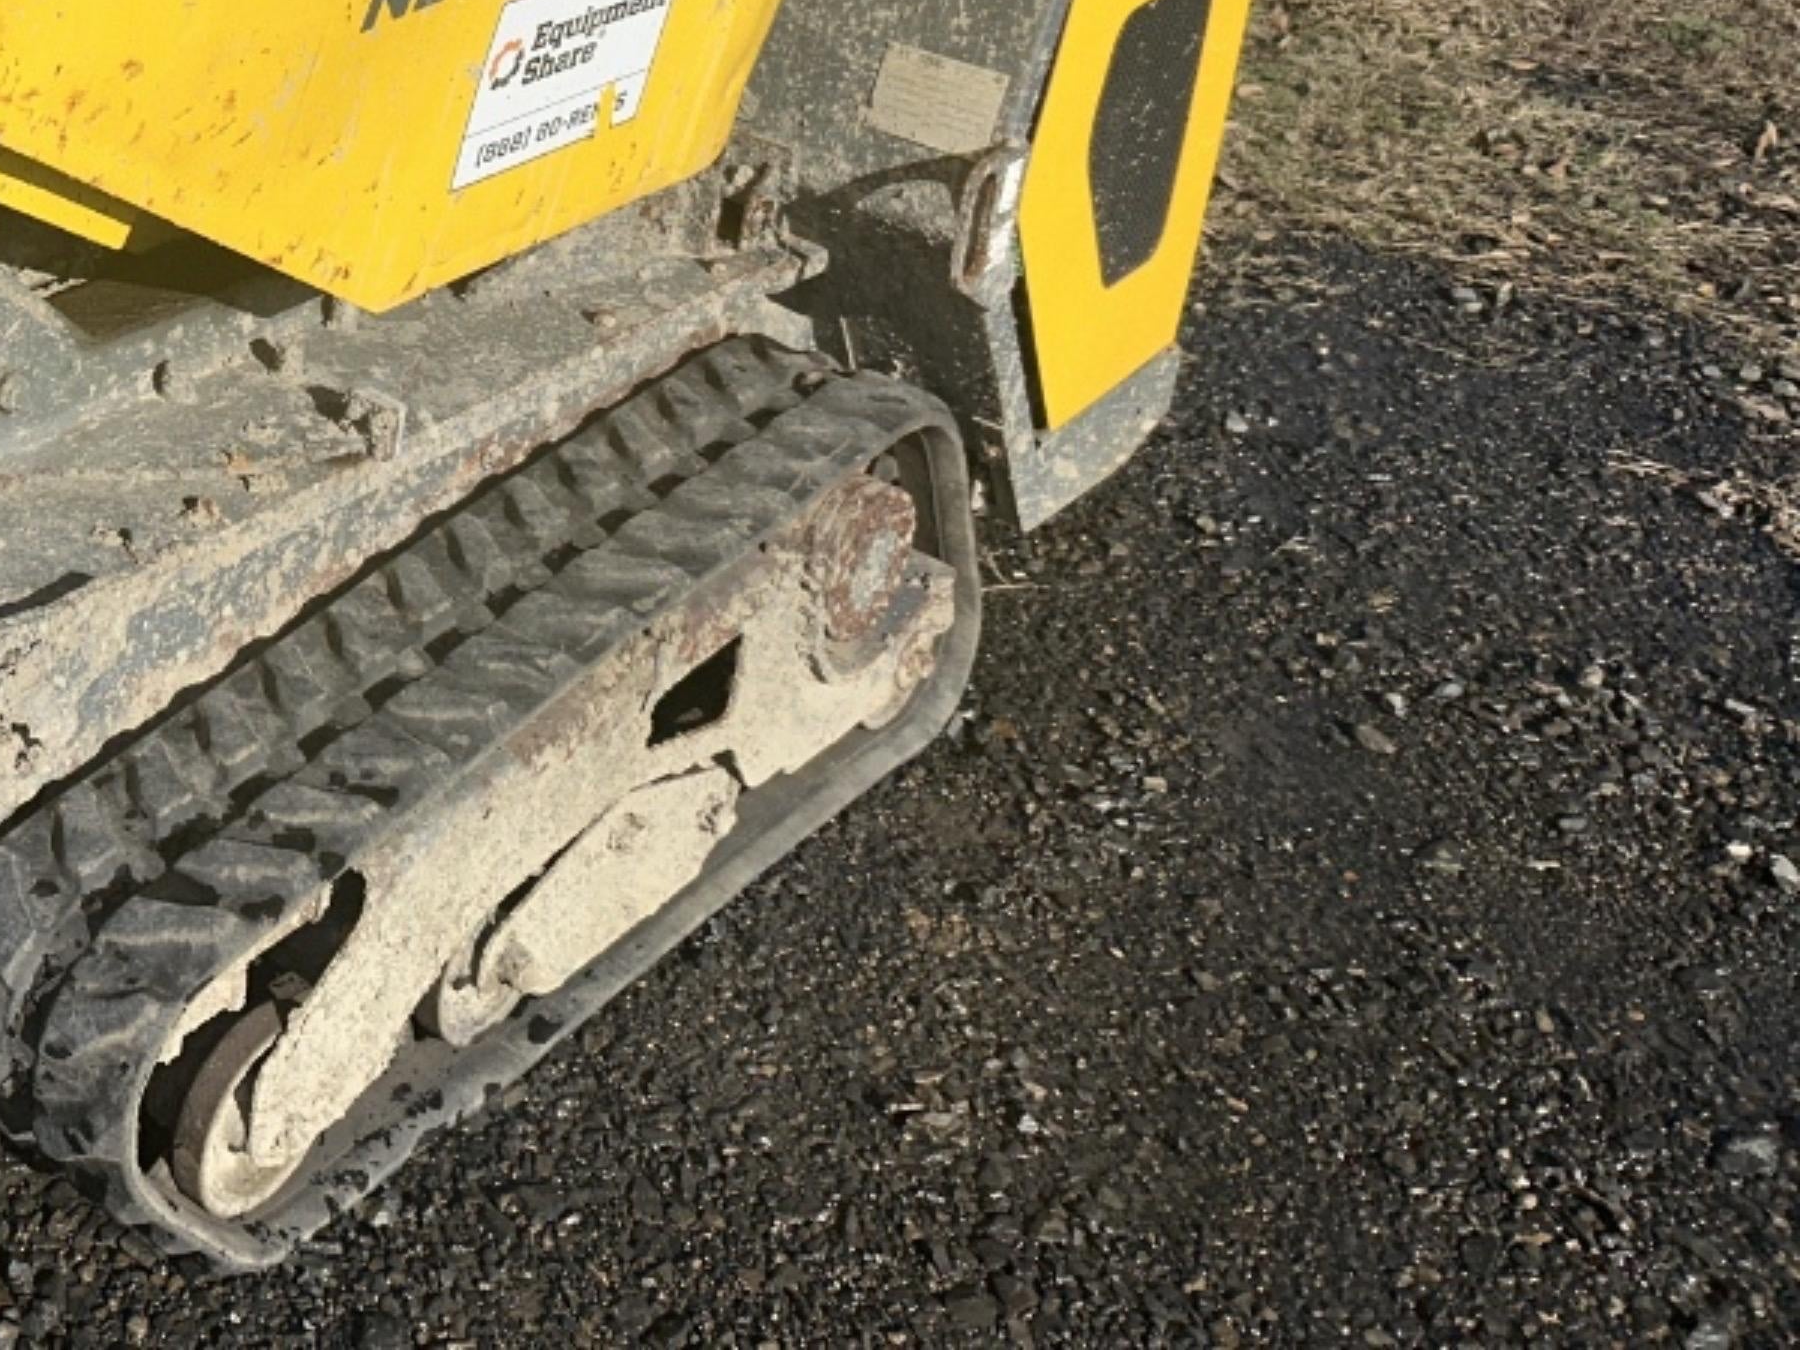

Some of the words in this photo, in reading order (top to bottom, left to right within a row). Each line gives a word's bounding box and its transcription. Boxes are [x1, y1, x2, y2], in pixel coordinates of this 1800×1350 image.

[521, 42, 598, 85] Share
[475, 125, 532, 168] (888)
[535, 90, 628, 143] 80-RENS
